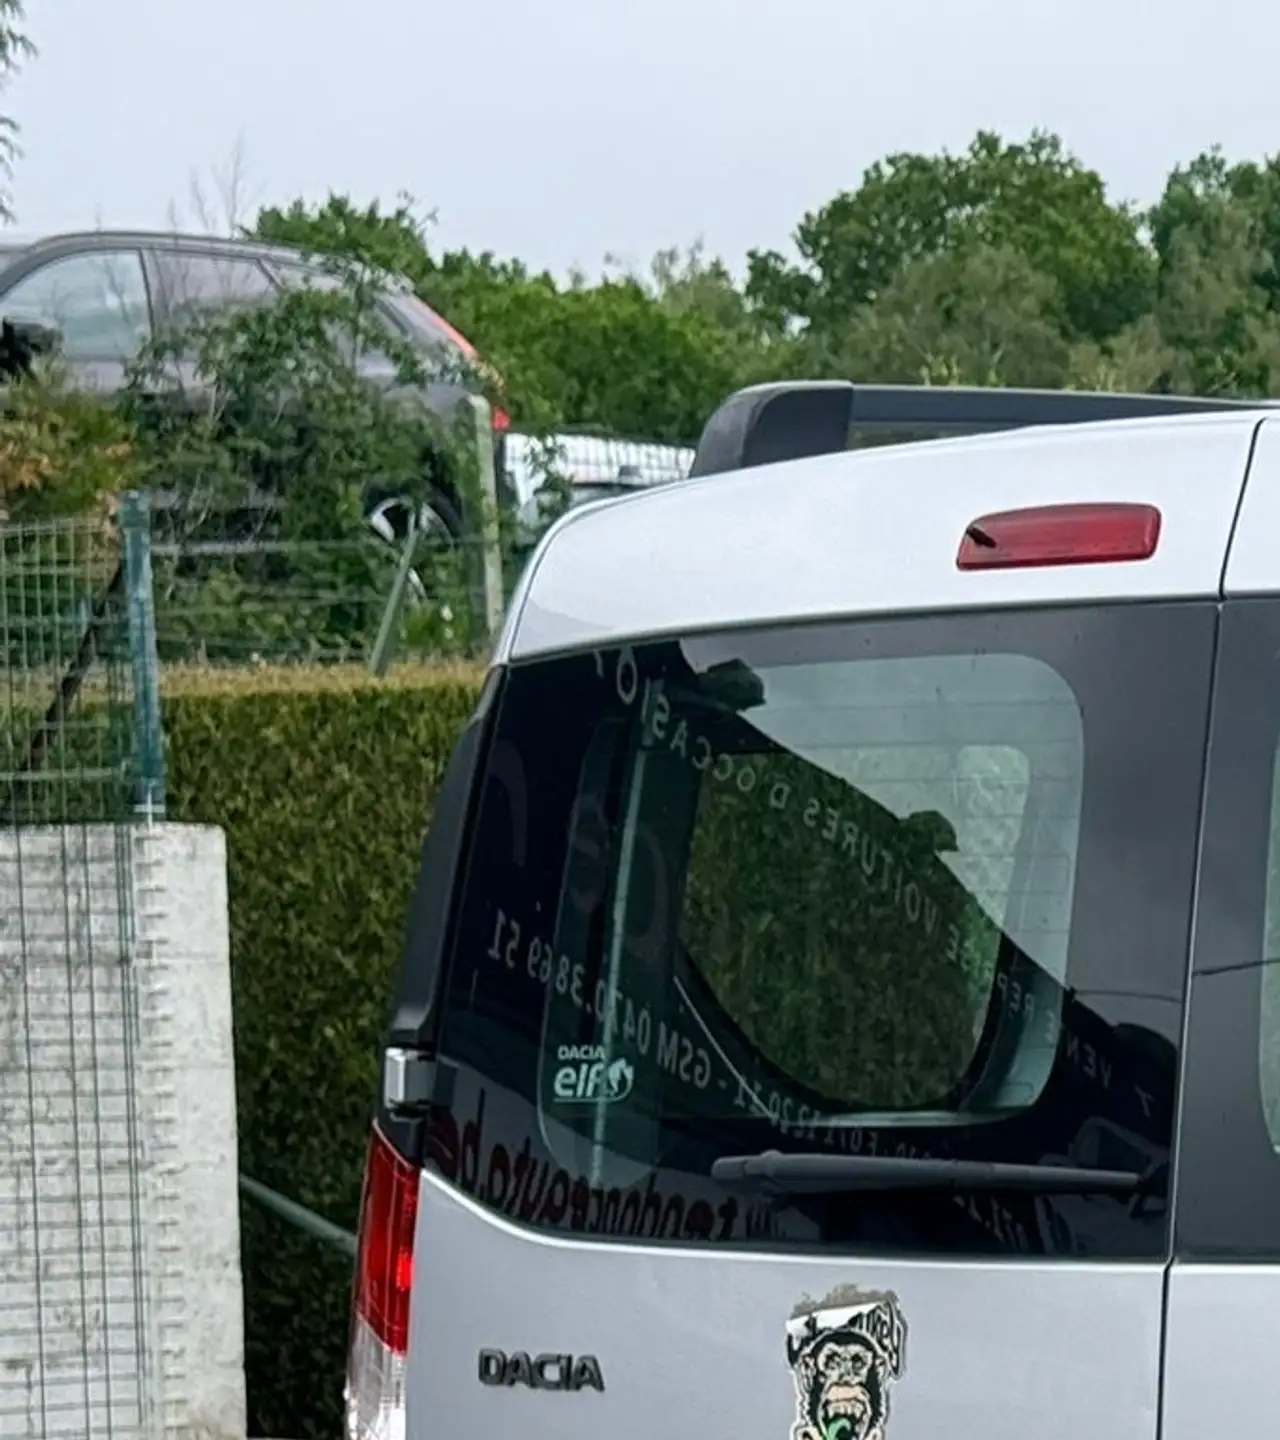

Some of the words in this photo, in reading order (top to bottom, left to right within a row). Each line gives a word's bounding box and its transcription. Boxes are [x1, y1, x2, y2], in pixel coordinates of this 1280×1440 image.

[558, 1044, 605, 1061] DACIA
[553, 1062, 605, 1098] elf
[478, 1348, 605, 1392] DACIA
